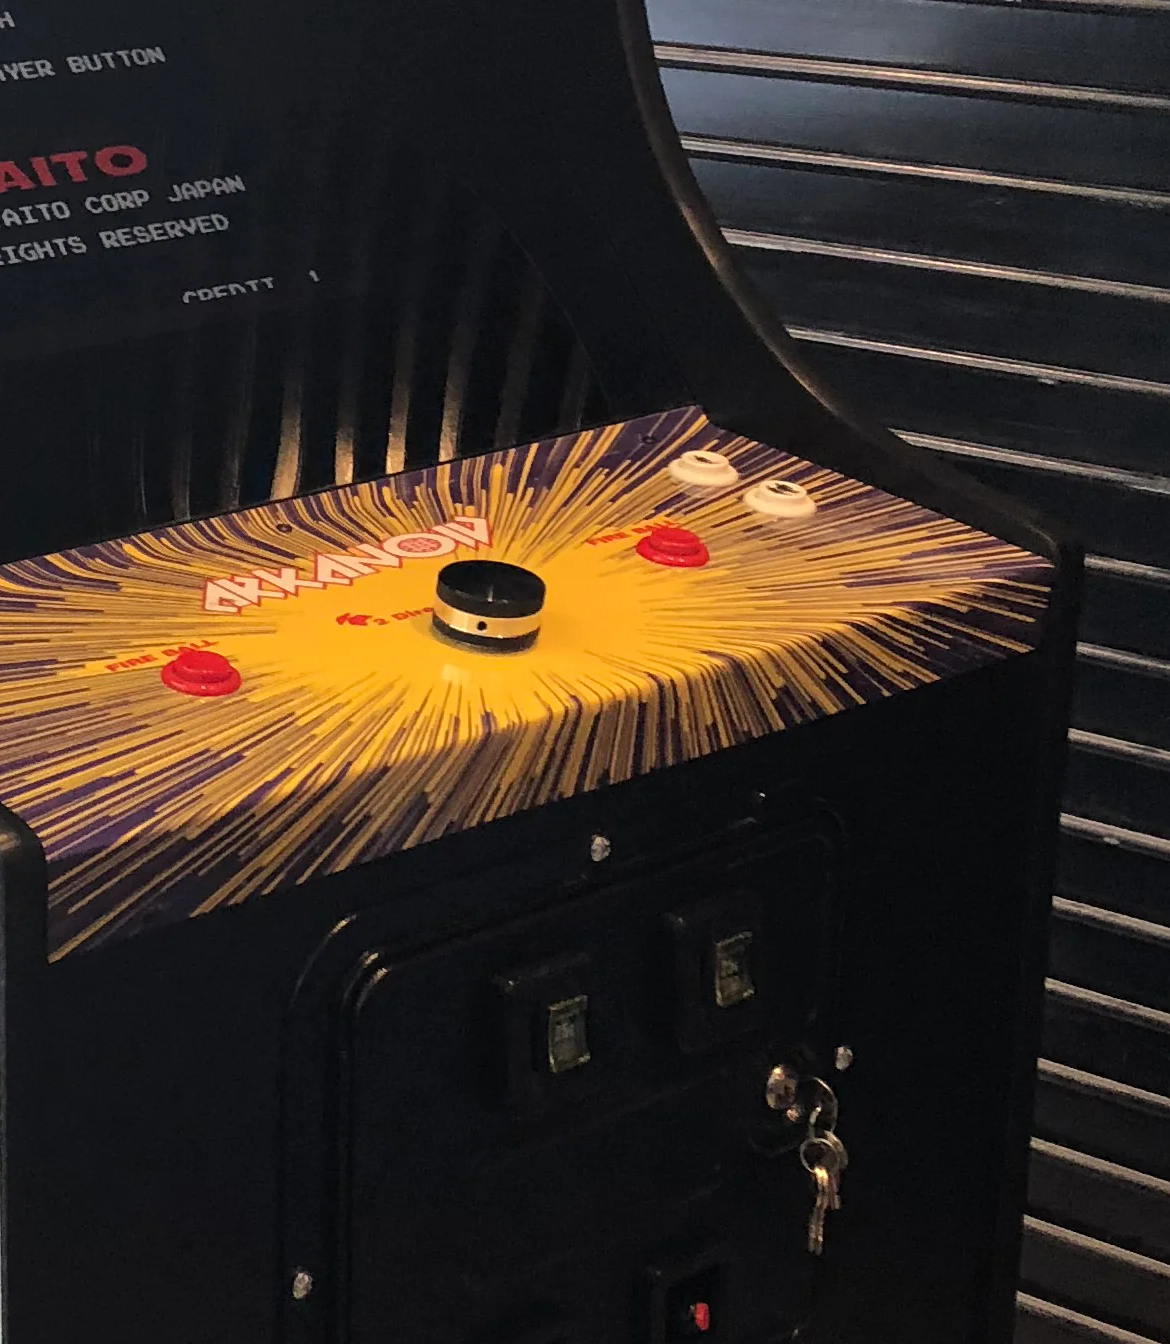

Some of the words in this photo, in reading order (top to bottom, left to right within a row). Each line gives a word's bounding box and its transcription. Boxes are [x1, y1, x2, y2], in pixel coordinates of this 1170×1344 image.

[65, 47, 167, 74] BUTTON
[85, 189, 151, 214] CORP
[167, 175, 246, 203] JAPAN
[99, 213, 230, 250] RESERVED
[202, 514, 492, 616] ARKANOID
